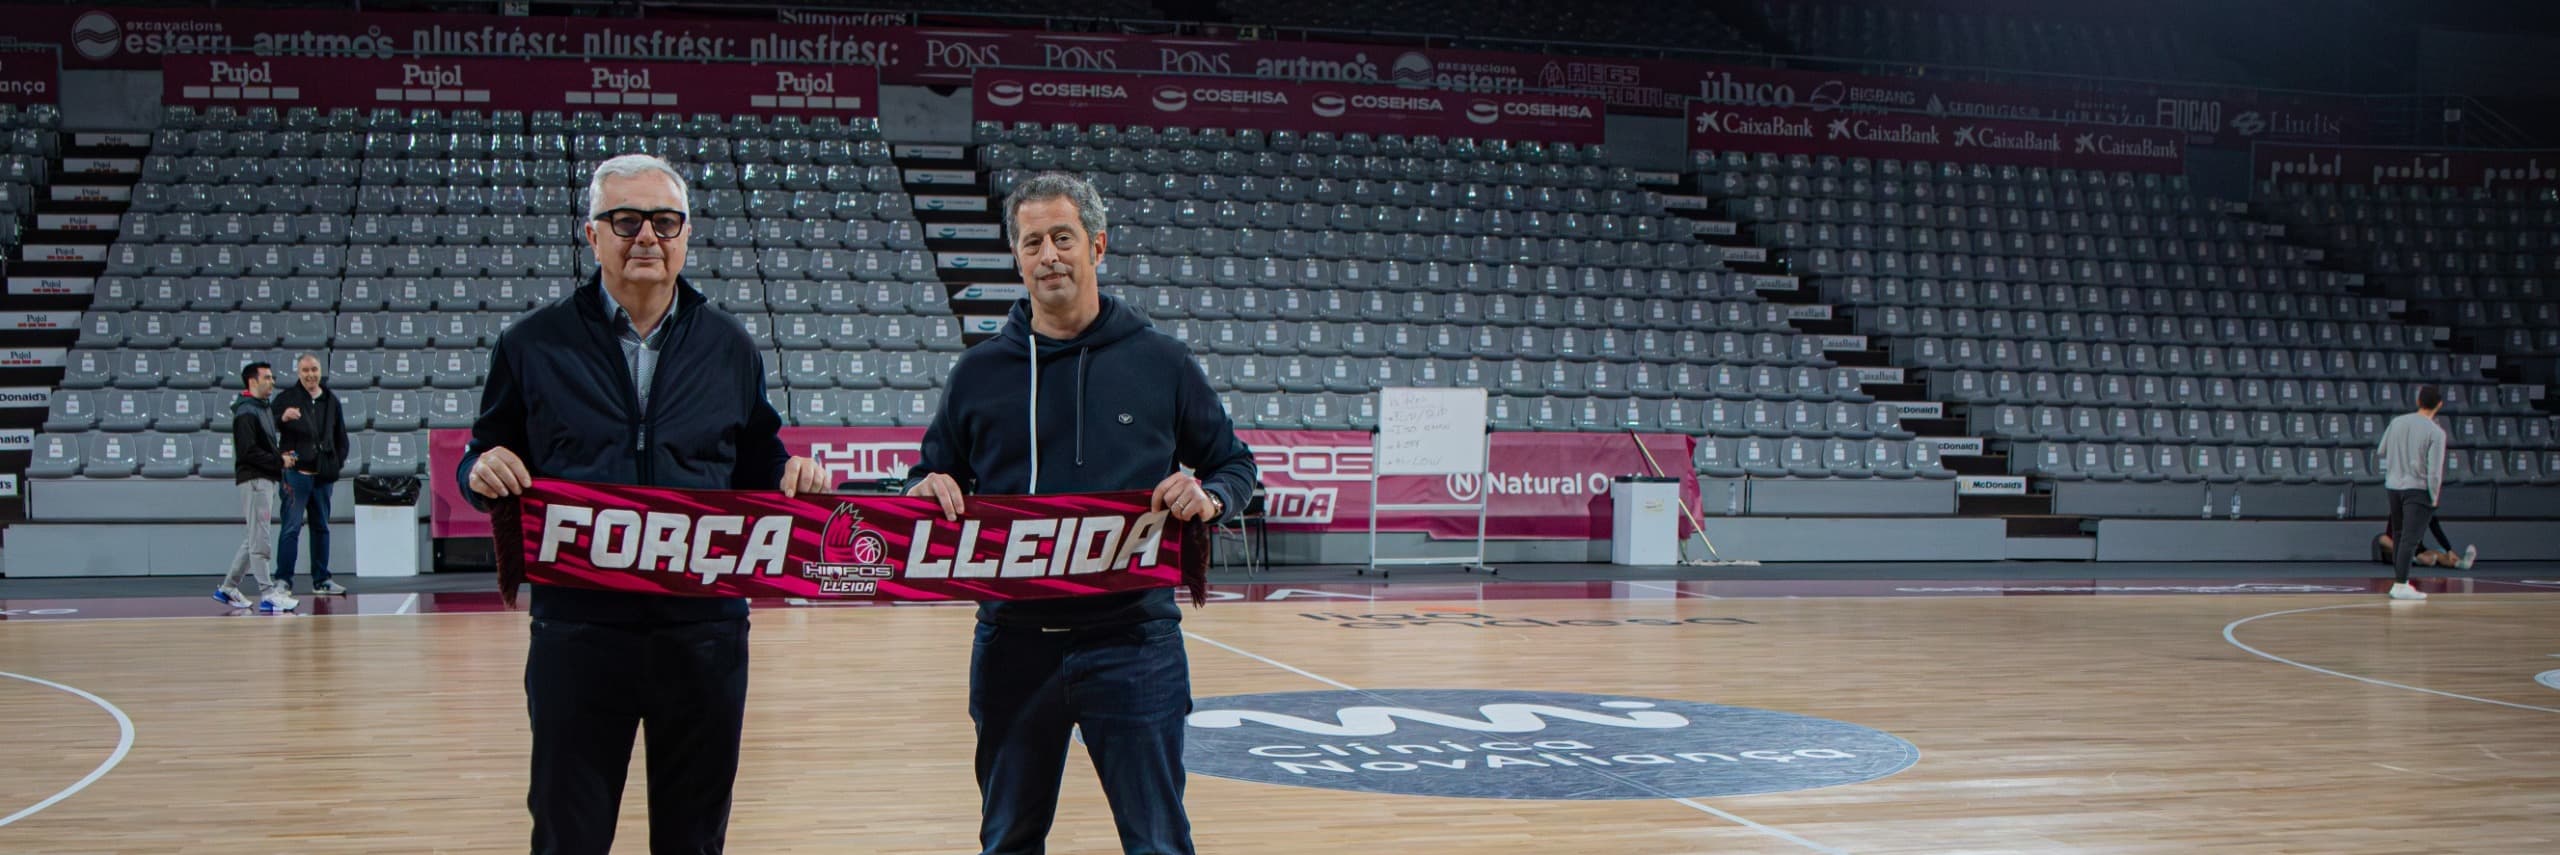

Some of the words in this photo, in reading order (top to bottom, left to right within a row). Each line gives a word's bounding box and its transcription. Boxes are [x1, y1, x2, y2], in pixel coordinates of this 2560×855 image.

[126, 20, 222, 33] excavacions
[125, 30, 232, 54] esterri
[925, 39, 1001, 67] PONS
[1044, 43, 1119, 71] PONS
[1160, 47, 1232, 74] PONS
[209, 61, 272, 87] Pujol
[402, 64, 463, 90] Pujol
[591, 67, 651, 92] Pujol
[776, 71, 835, 95] Pujol
[1029, 83, 1128, 99] COSEHISA
[1193, 88, 1289, 105] COSEHISA
[1351, 95, 1443, 112] COSEHISA
[1503, 102, 1592, 119] COSEHISA
[1723, 113, 1814, 137] CaixaBank
[1853, 120, 1940, 145] CaixaBank
[1978, 128, 2061, 153] CaixaBank
[2098, 135, 2178, 159] CaixaBank
[1897, 406, 1939, 414] cDonald's
[1938, 442, 1979, 451] cDonald's
[1487, 472, 1582, 495] Natural
[1972, 480, 2022, 489] McDonald's
[538, 503, 794, 585] FORÇA
[904, 509, 1171, 579] LLEIDA
[822, 581, 875, 592] LLEIDA
[1339, 617, 1757, 629] endesa
[1247, 739, 1595, 758] Clínica
[1271, 747, 1856, 775] NovAliança
